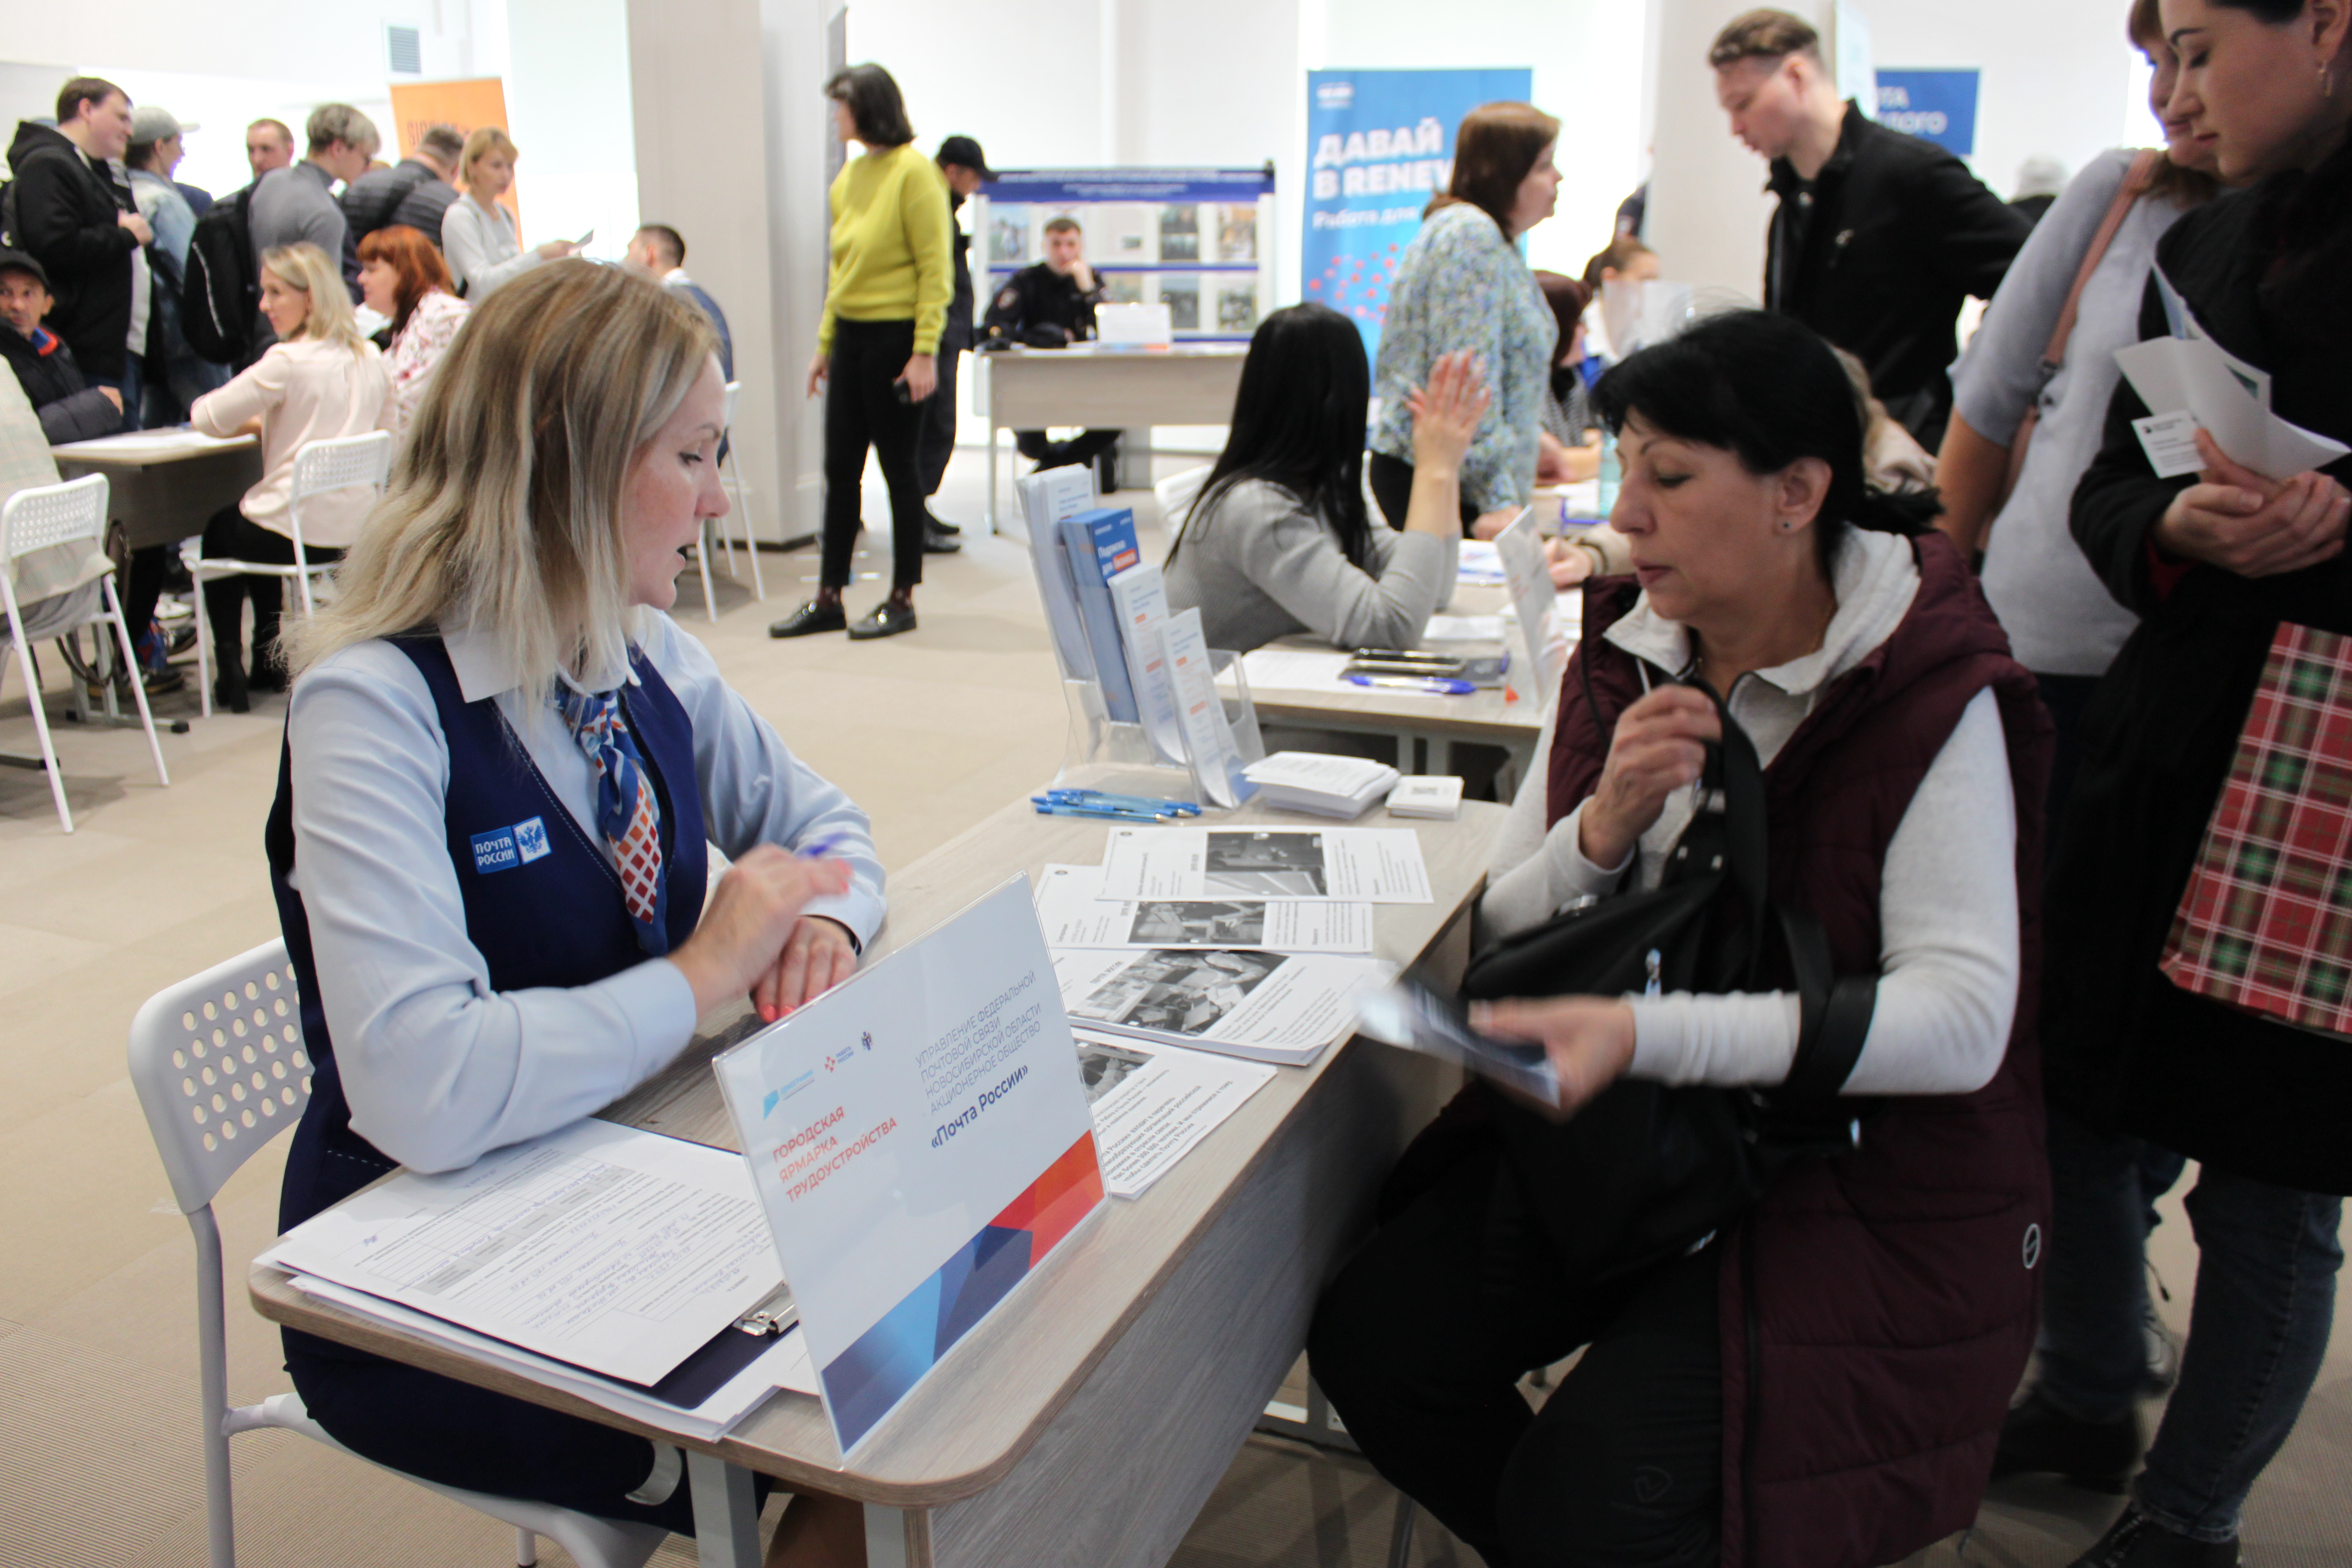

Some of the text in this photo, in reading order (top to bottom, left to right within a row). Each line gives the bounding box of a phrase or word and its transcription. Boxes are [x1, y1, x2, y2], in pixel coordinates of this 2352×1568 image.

[1313, 116, 1443, 169] ДАВАЙ
[475, 836, 512, 854] ПОЧТА
[477, 848, 515, 866] РОССИИ
[915, 970, 1036, 1068] УПРАВЛЕНИЕ ФЕДЕРАЛЬНОЙ
[835, 1046, 851, 1058] РАБОТА
[837, 1050, 854, 1064] РОССИИ
[921, 1017, 1001, 1083] ПОЧТОВОЙ СВЯЗИ
[925, 1003, 1041, 1099] НОВОСИБИРСКОЙ ОБЛАСТИ
[931, 1021, 1040, 1116] АКЦИОНЕРНОЕ ОБЩЕСТВО
[773, 1106, 844, 1163] ГОРОДСКАЯ
[931, 1065, 1029, 1148] «Почта России»
[779, 1136, 838, 1183] ЯРМАРКА
[785, 1117, 897, 1202] ТРУДОУСТРОЙСТВА
